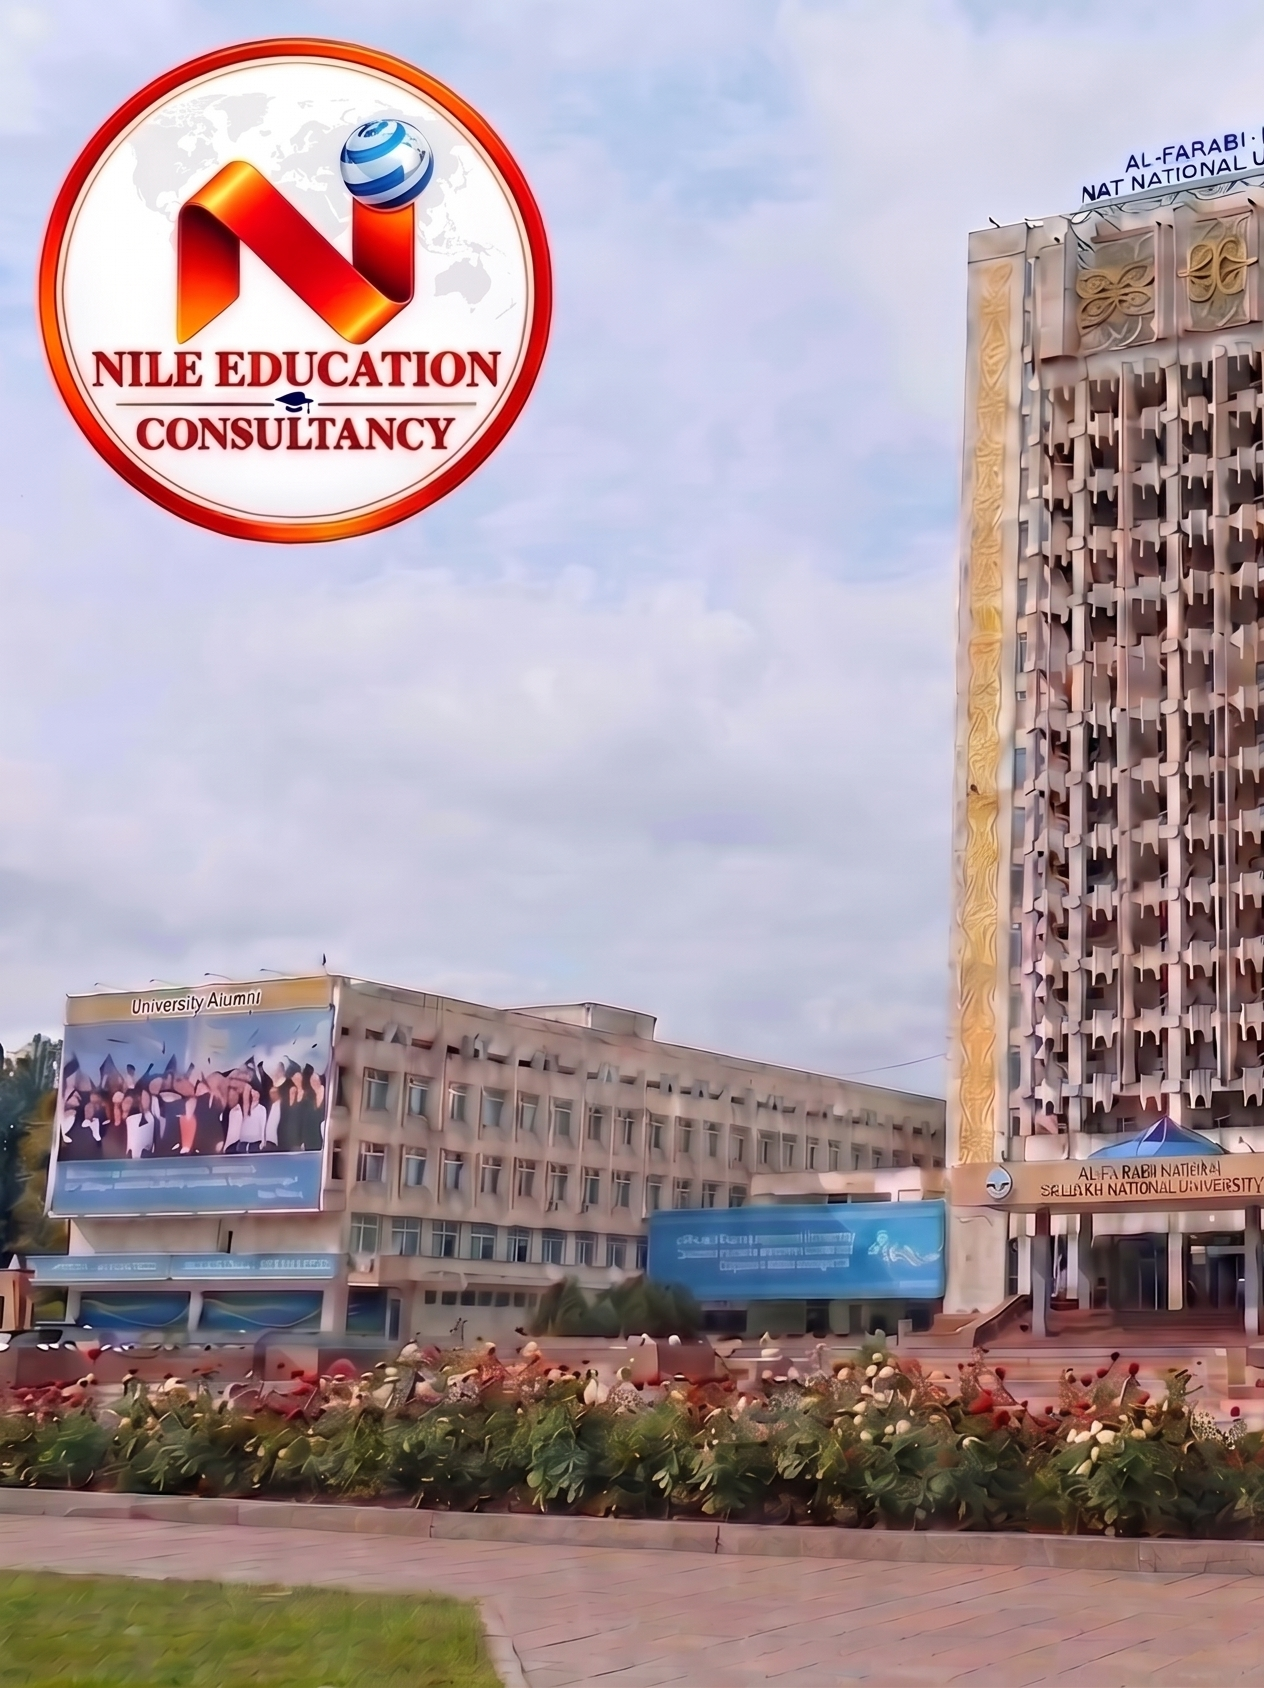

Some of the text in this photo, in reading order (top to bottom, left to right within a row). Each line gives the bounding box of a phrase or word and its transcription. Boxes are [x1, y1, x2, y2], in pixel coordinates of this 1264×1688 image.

[1125, 131, 1246, 173] AL-FARABI
[1081, 178, 1125, 203] NAT
[1131, 155, 1247, 191] NATIONAL
[132, 995, 204, 1018] University
[1107, 1179, 1177, 1197] NATIONAL
